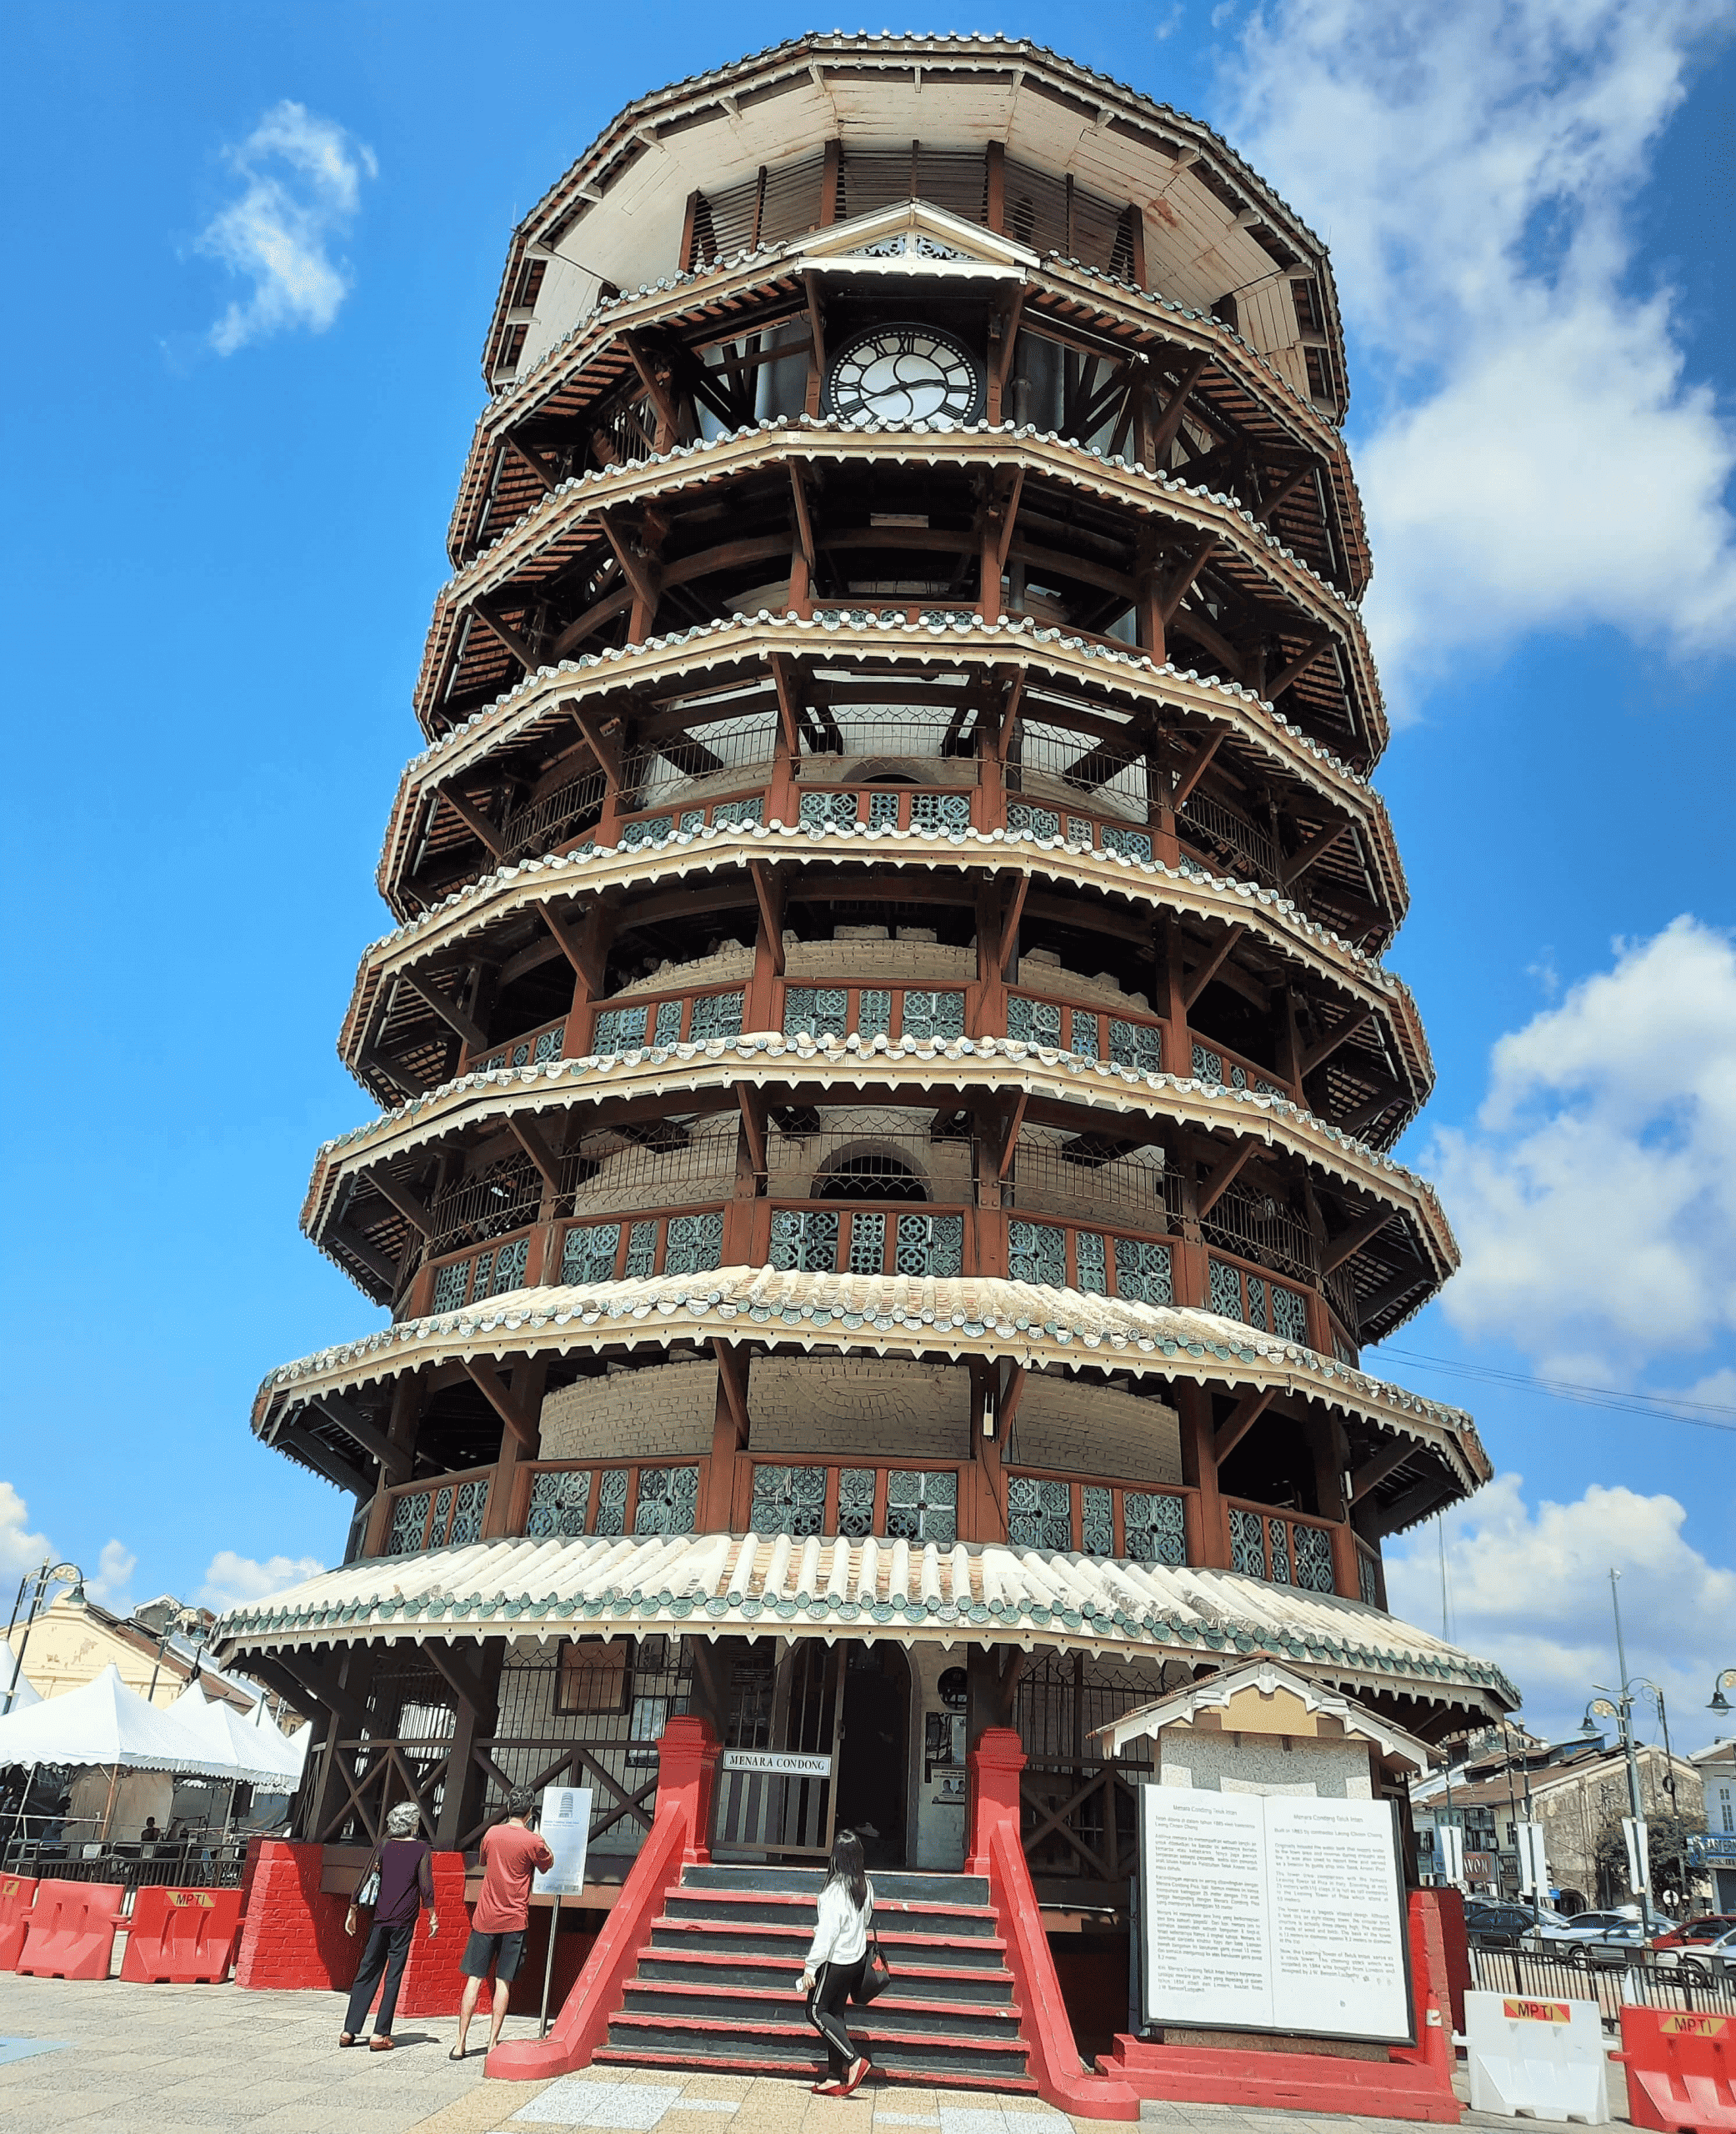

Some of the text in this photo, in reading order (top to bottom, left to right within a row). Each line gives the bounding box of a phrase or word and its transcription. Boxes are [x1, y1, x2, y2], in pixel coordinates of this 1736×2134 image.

[729, 1755, 825, 1771] MENARA CONDONG
[175, 1894, 206, 1906] MPTI
[1518, 2002, 1553, 2021] MPTI
[1673, 2016, 1713, 2035] MPTI
